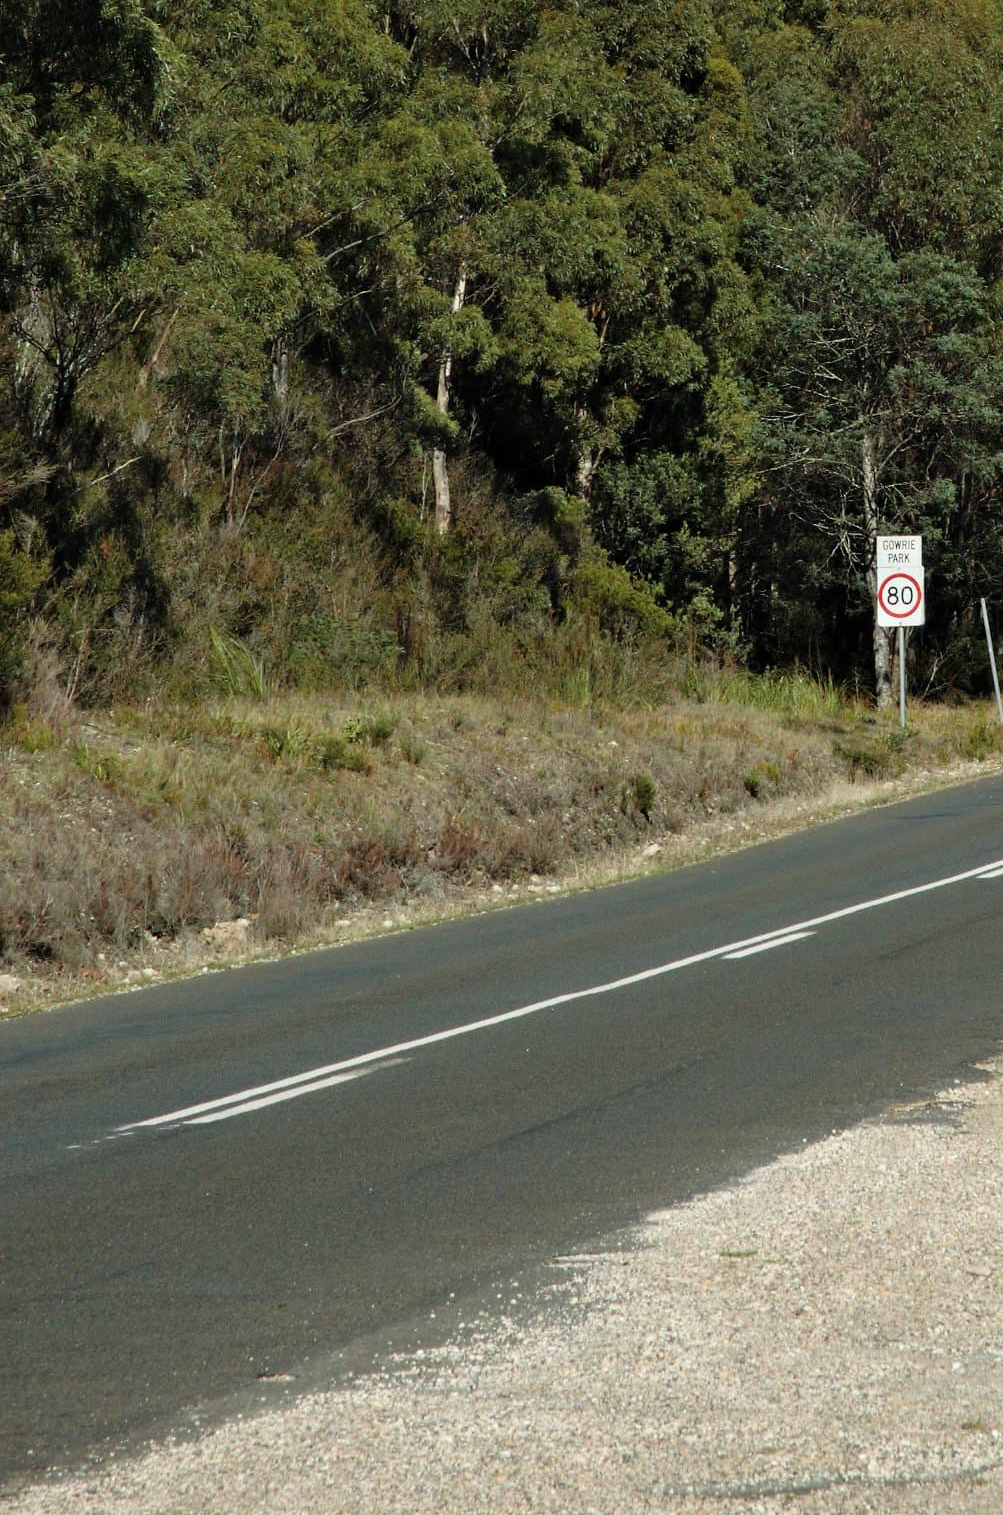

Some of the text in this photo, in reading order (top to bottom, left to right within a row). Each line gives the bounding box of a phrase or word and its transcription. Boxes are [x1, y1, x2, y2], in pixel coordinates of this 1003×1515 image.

[883, 540, 916, 550] GOWRIE
[888, 553, 910, 563] PARK
[887, 586, 913, 605] 80
